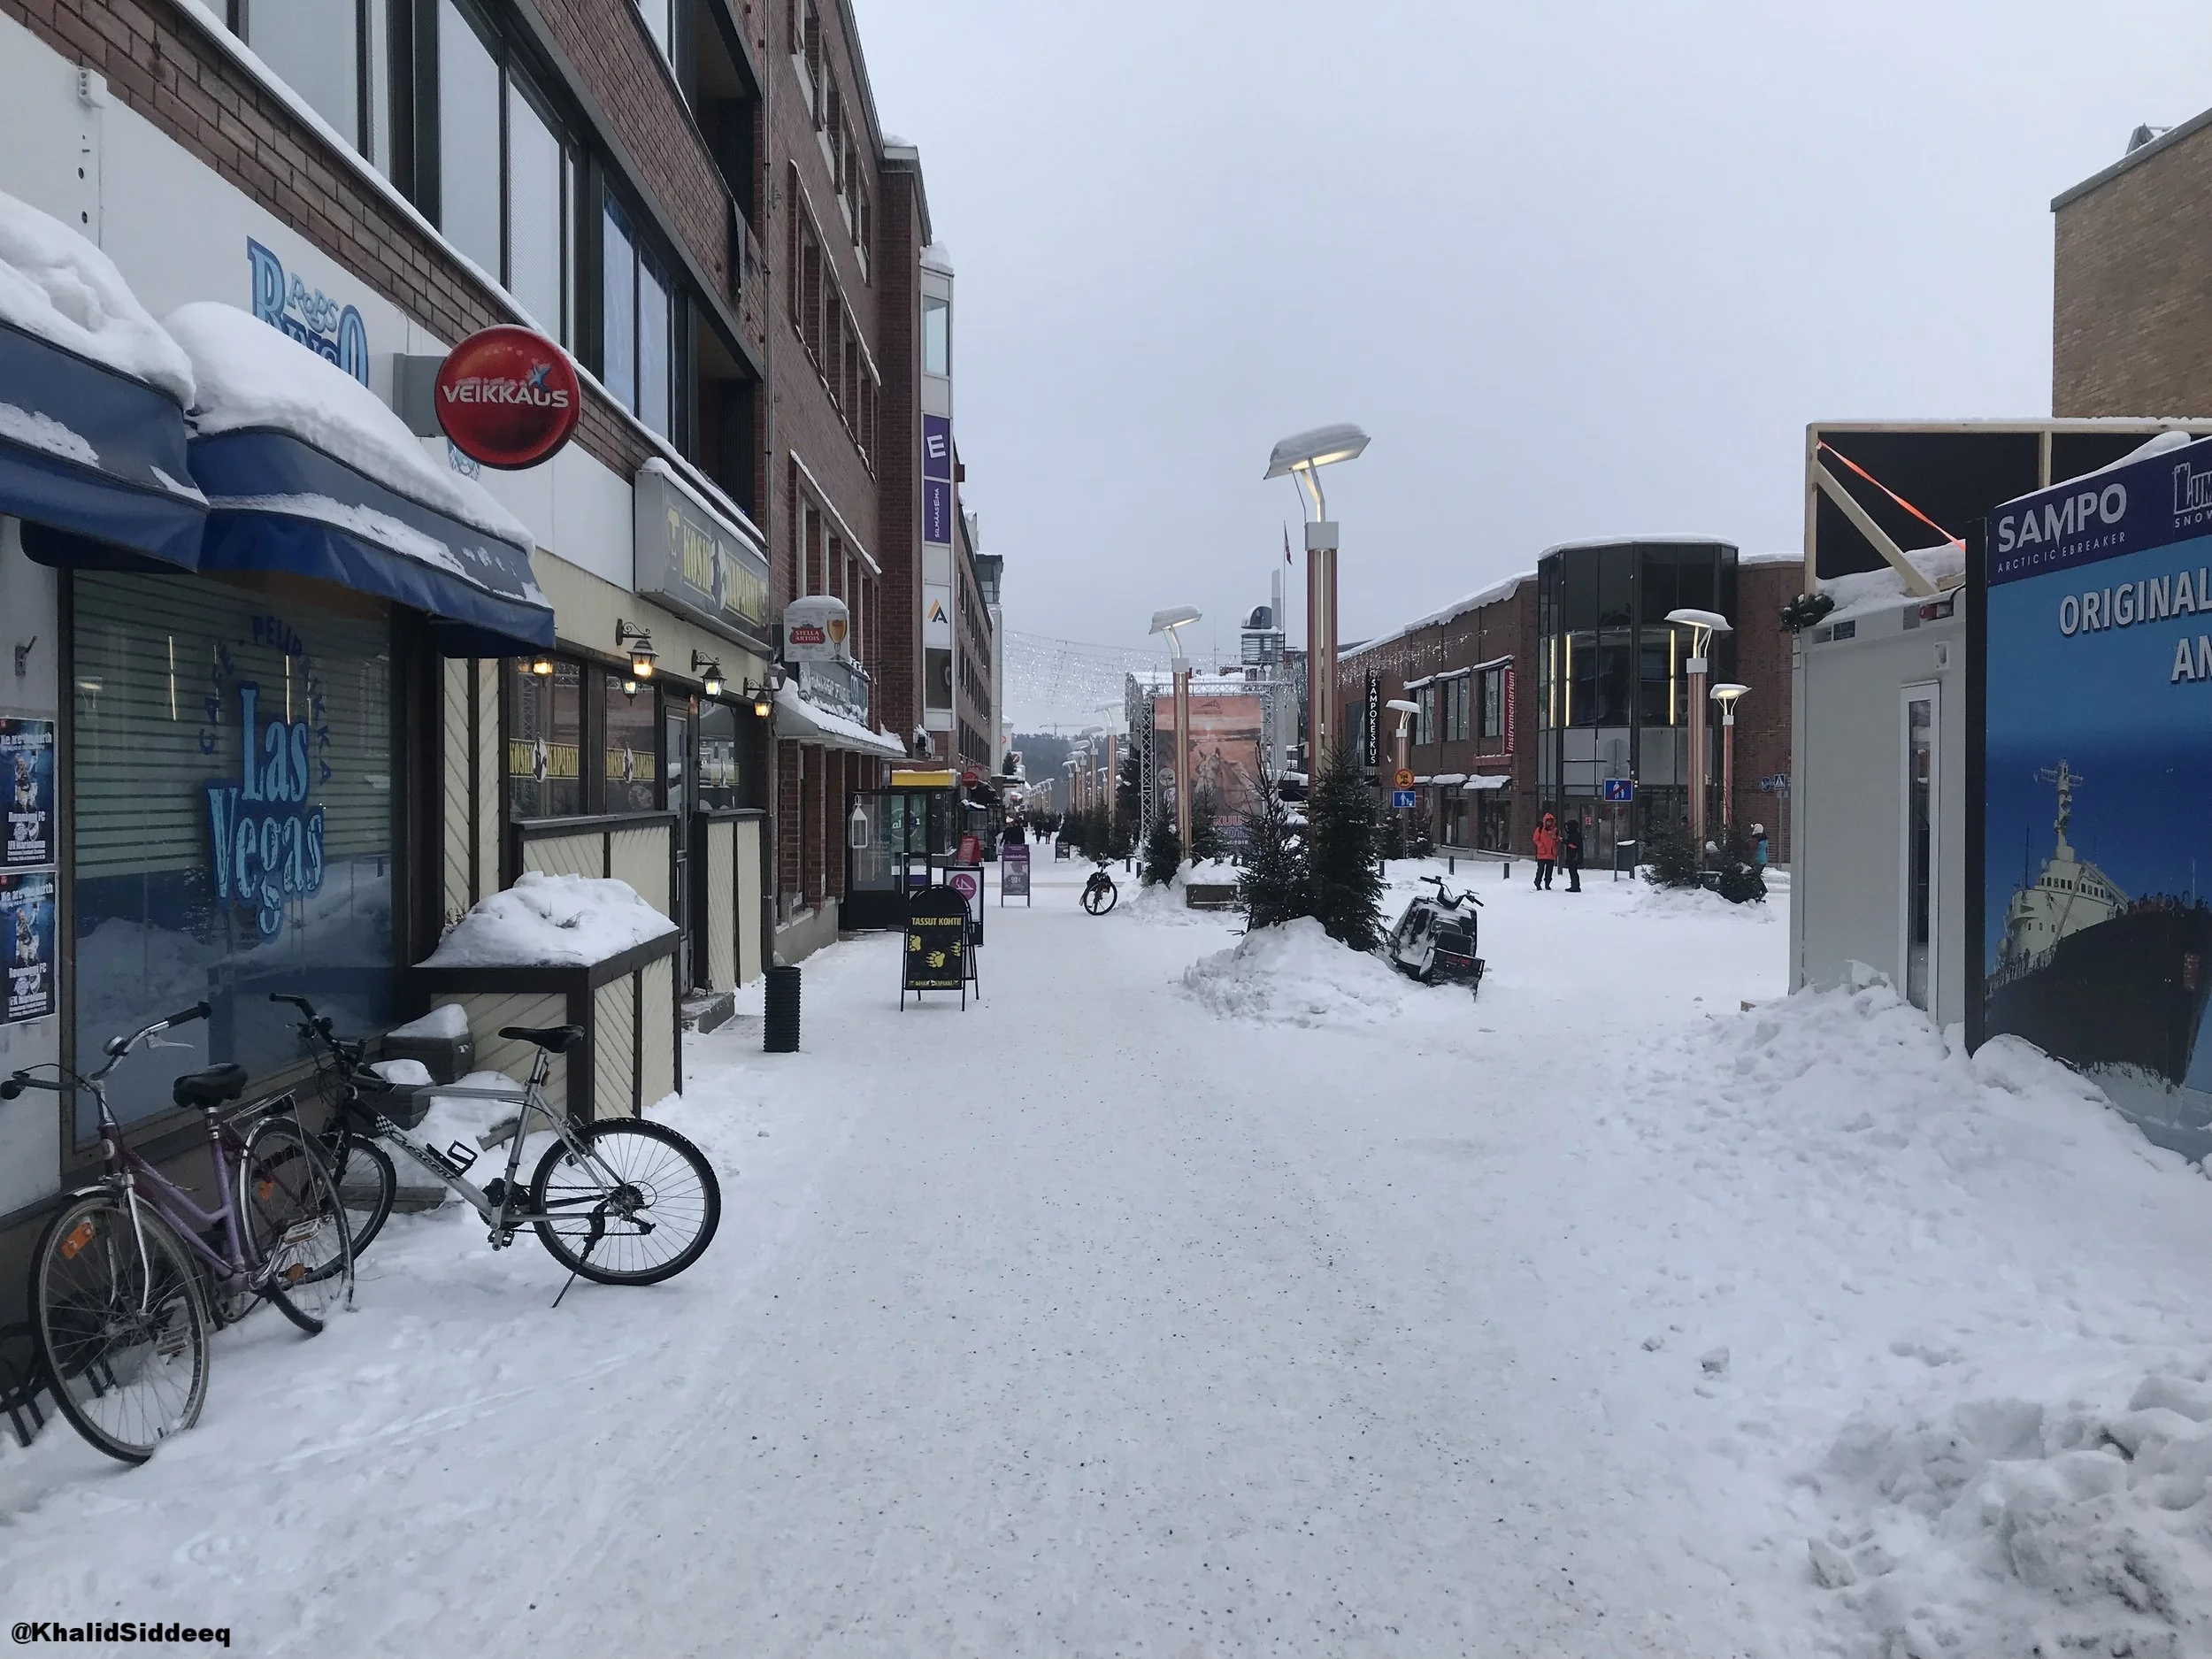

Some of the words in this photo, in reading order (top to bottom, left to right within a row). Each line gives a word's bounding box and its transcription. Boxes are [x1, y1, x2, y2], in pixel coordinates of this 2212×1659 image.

[442, 384, 569, 408] VEIKKAUS
[1998, 483, 2127, 554] SAMPO
[1997, 554, 2039, 572] ARCTIC
[2059, 567, 2212, 635] ORIGINAL
[241, 687, 308, 802] Las
[1369, 678, 1378, 764] SAMPOKESKUS
[208, 787, 322, 935] Vegas
[911, 917, 937, 926] TASSUT
